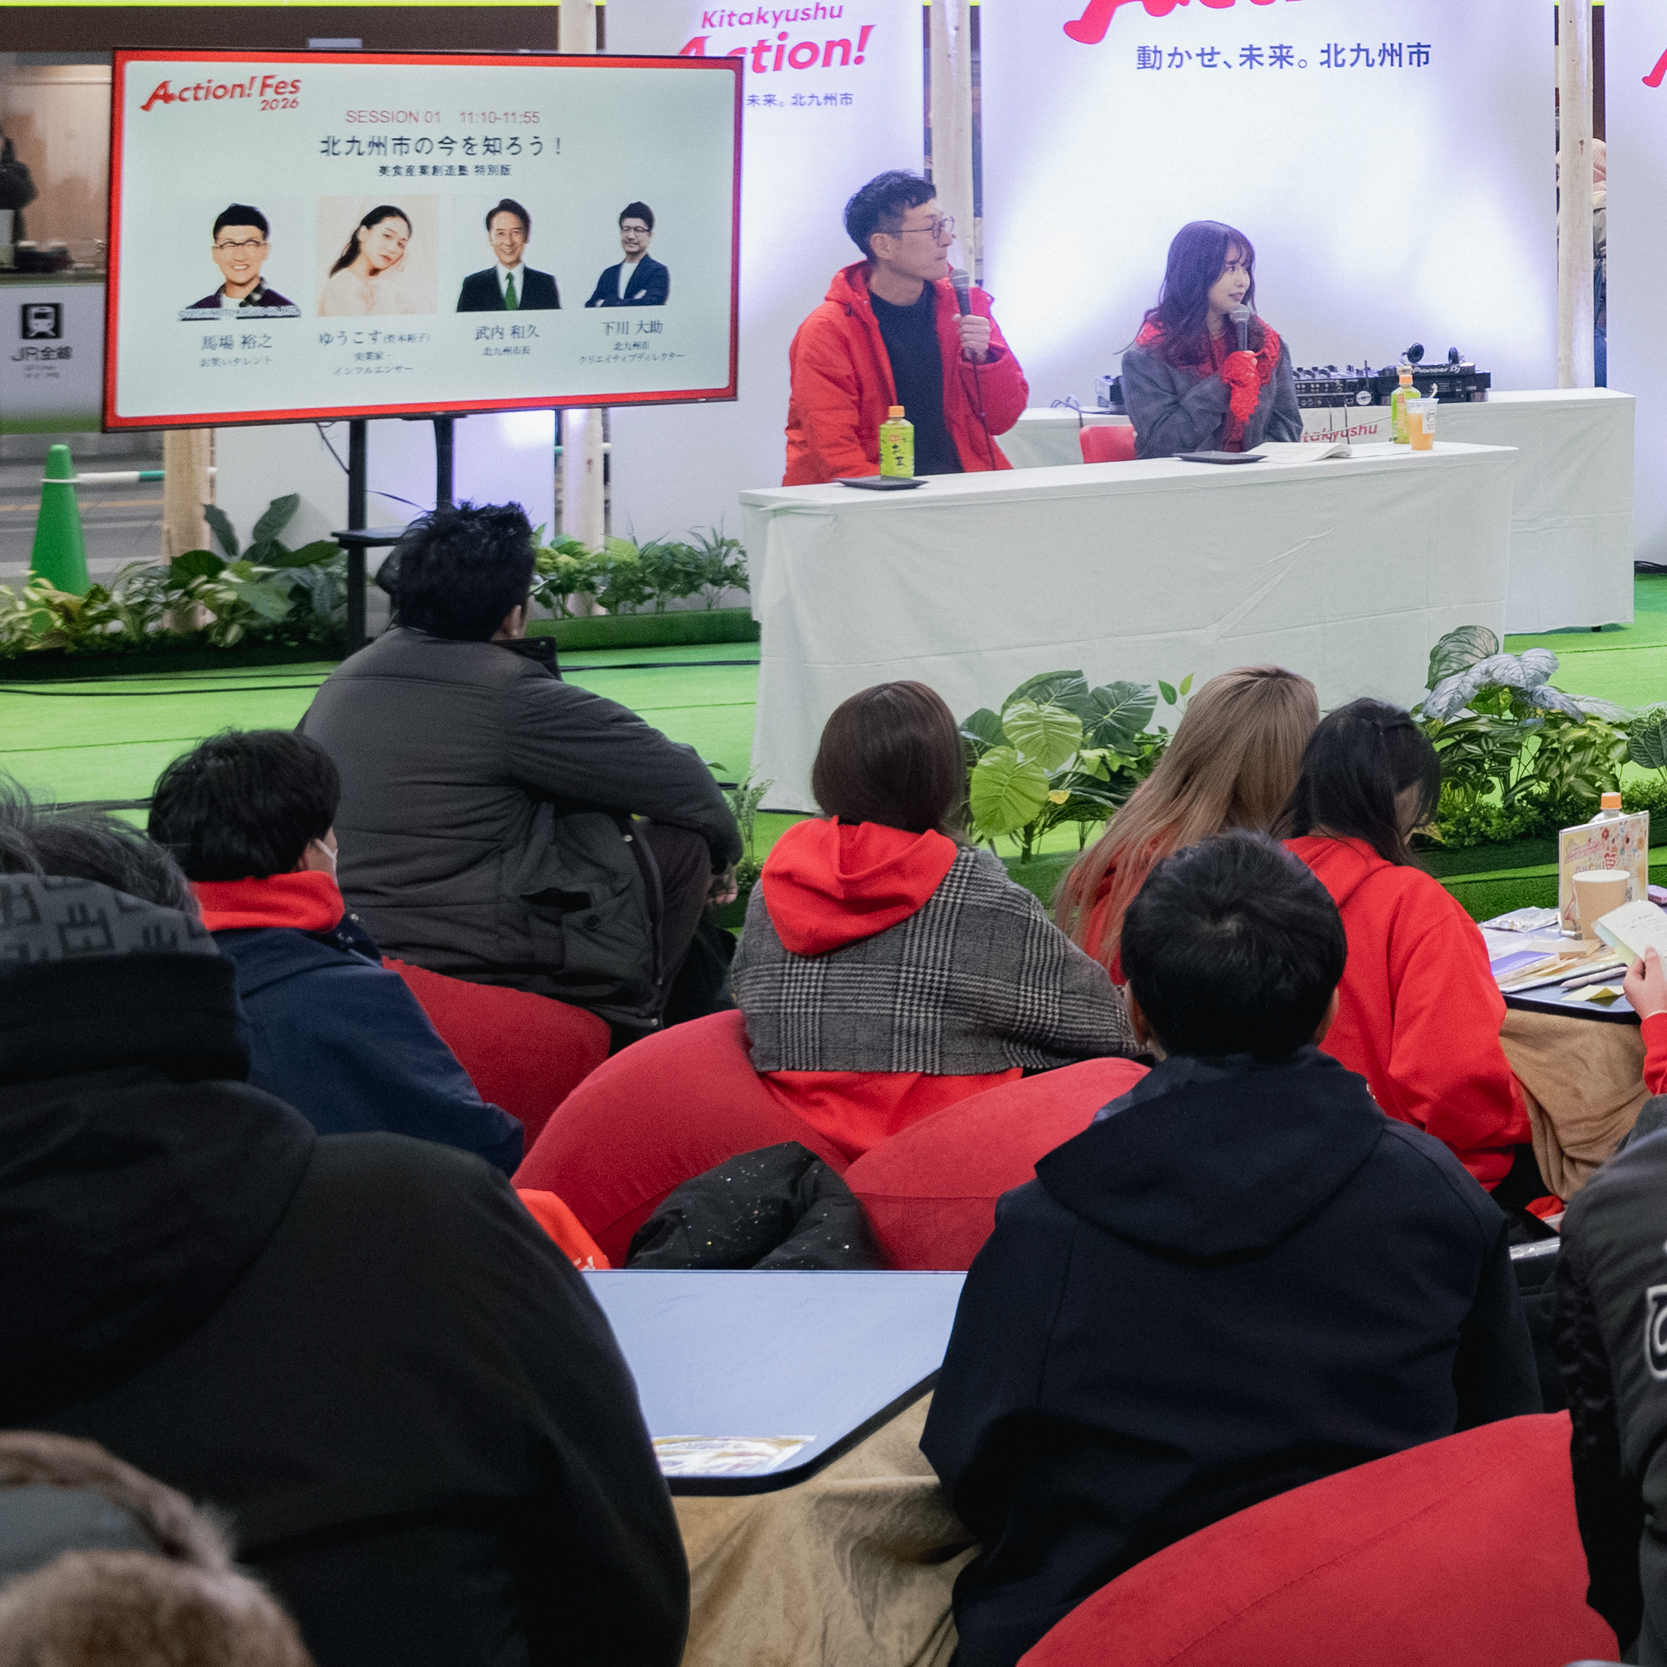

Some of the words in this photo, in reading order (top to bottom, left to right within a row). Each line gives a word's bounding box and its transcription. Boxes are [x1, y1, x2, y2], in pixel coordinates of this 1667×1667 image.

[701, 2, 844, 29] Kitakyushu
[1136, 41, 1433, 71] 動かせ、未来。北九州市
[140, 75, 258, 113] Action!
[259, 74, 302, 97] Fes
[260, 97, 300, 112] 2026
[345, 110, 420, 124] SESSION
[424, 110, 441, 124] 01
[459, 110, 541, 124] 11:10-11:55
[475, 325, 505, 341] 武内
[510, 324, 540, 340] 和久
[602, 320, 630, 336] 下川
[635, 319, 664, 335] 大助
[1412, 366, 1449, 374] Pioneer
